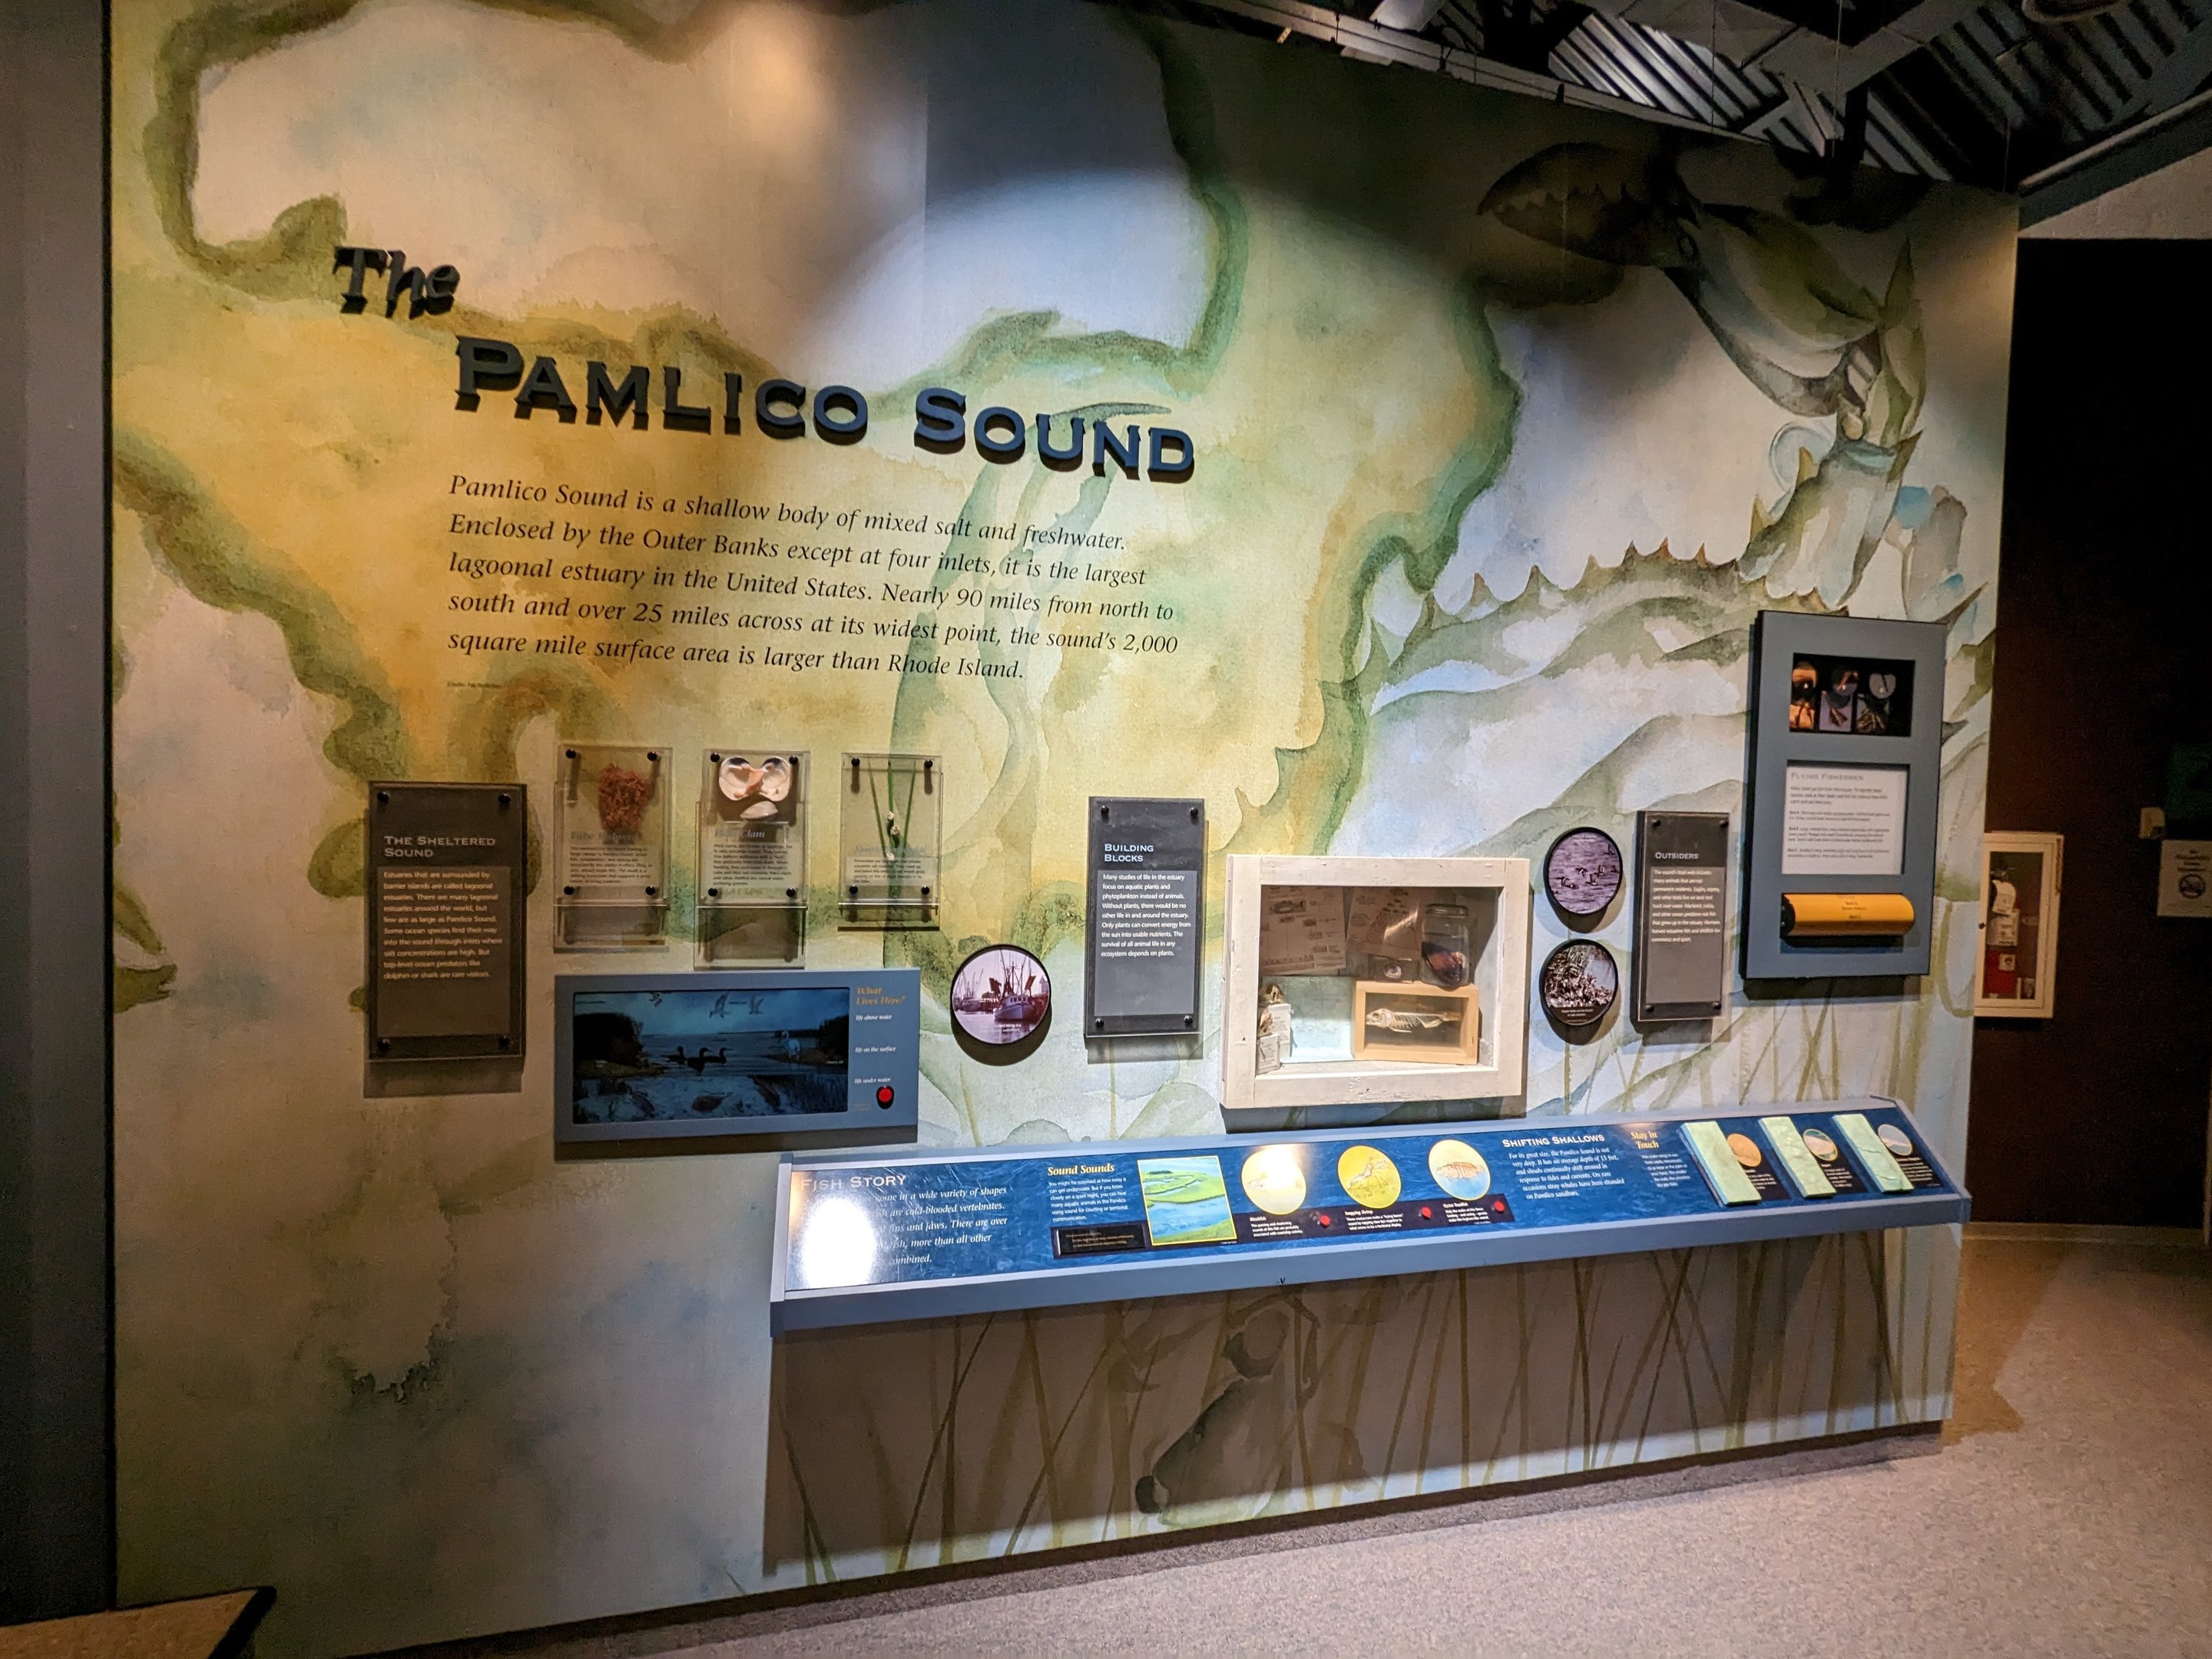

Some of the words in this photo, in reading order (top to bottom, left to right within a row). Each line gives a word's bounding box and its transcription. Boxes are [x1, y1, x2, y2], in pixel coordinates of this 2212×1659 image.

[333, 245, 461, 318] The
[455, 335, 868, 445] PAMLICO
[914, 387, 1194, 483] SOUND
[449, 475, 547, 500] Pamlico
[555, 485, 628, 508] Sound
[636, 491, 654, 510] is
[662, 498, 675, 512] a
[684, 496, 770, 519] shallow
[777, 503, 830, 529] body
[836, 508, 861, 532] of
[864, 512, 928, 532] mixed
[934, 515, 972, 536] salt
[979, 523, 1017, 540] and
[1022, 525, 1124, 549] freshwater.
[449, 514, 555, 539] Enclosed
[562, 522, 591, 548] by
[599, 525, 634, 545] the
[643, 529, 706, 551] Outer
[714, 535, 779, 557] Banks
[787, 545, 853, 567] except
[859, 548, 882, 565] at
[888, 548, 931, 571] four
[938, 552, 995, 576] inlets,
[1005, 555, 1020, 575] it
[1026, 556, 1041, 577] is
[1049, 561, 1078, 579] the
[1085, 564, 1147, 587] largest
[449, 552, 553, 578] lagoonal
[561, 564, 644, 588] estuary
[654, 567, 674, 585] in
[684, 569, 717, 588] the
[727, 572, 798, 594] United
[804, 578, 872, 599] States.
[880, 583, 949, 608] Nearly
[956, 588, 983, 607] 90
[989, 592, 1041, 611] miles
[1047, 594, 1092, 616] from
[1099, 601, 1149, 618] north
[1156, 604, 1174, 620] to
[448, 594, 515, 612] south
[524, 598, 570, 615] and
[578, 604, 626, 619] over
[633, 603, 663, 622] 25
[672, 606, 729, 626] miles
[737, 614, 803, 631] across
[811, 616, 833, 632] at
[840, 615, 865, 634] its
[873, 619, 939, 639] widest
[943, 624, 1001, 645] point,
[1010, 627, 1040, 644] the
[1046, 631, 1116, 649] sound's
[1122, 634, 1178, 654] 2,000
[448, 634, 527, 654] square
[535, 635, 587, 654] mile
[594, 639, 675, 662] surface
[683, 647, 729, 662] area
[738, 645, 755, 664] is
[764, 647, 825, 671] larger
[832, 651, 879, 670] than
[887, 654, 950, 674] Rhode
[956, 658, 1023, 678] Island.
[383, 836, 412, 845] THE
[417, 836, 495, 846] SHELTERED
[1104, 843, 1154, 852] BUILDING
[384, 848, 433, 857] SOUND
[1104, 853, 1144, 862] BLOCKS
[1502, 1137, 1550, 1147] SHIFTING
[1551, 1134, 1604, 1144] SHALLOWS
[1631, 1131, 1647, 1140] Stay
[1636, 1141, 1659, 1149] Touch
[1048, 1165, 1078, 1176] Sound
[1080, 1163, 1114, 1174] Sounds
[849, 1175, 907, 1188] STORY
[919, 1190, 937, 1199] wide
[940, 1188, 968, 1199] variety
[969, 1187, 980, 1198] of
[980, 1186, 1007, 1197] shapes
[890, 1207, 903, 1216] are
[906, 1204, 957, 1215] cold-blooded
[959, 1202, 1005, 1211] vertebrates.
[907, 1222, 922, 1231] and
[925, 1220, 947, 1233] jaws.
[950, 1219, 973, 1228] There
[991, 1217, 1008, 1226] over
[934, 1237, 954, 1246] than
[956, 1233, 968, 1244] all
[970, 1233, 992, 1243] other
